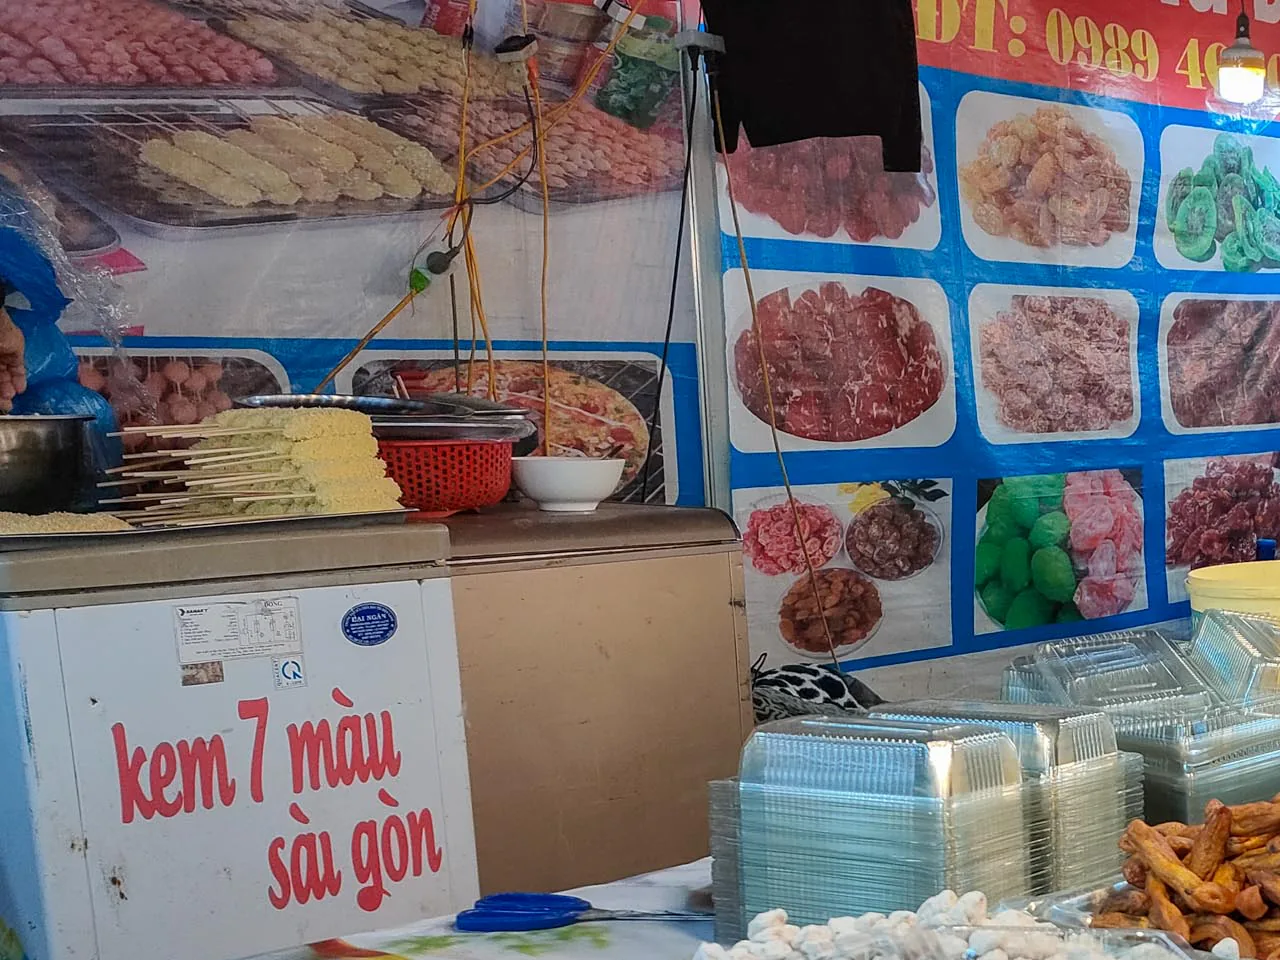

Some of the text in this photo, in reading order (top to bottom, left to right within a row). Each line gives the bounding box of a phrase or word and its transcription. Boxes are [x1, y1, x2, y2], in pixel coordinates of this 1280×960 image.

[1046, 7, 1160, 82] 0989
[111, 687, 401, 824] kem 7 màu
[268, 788, 442, 912] sài gòn
